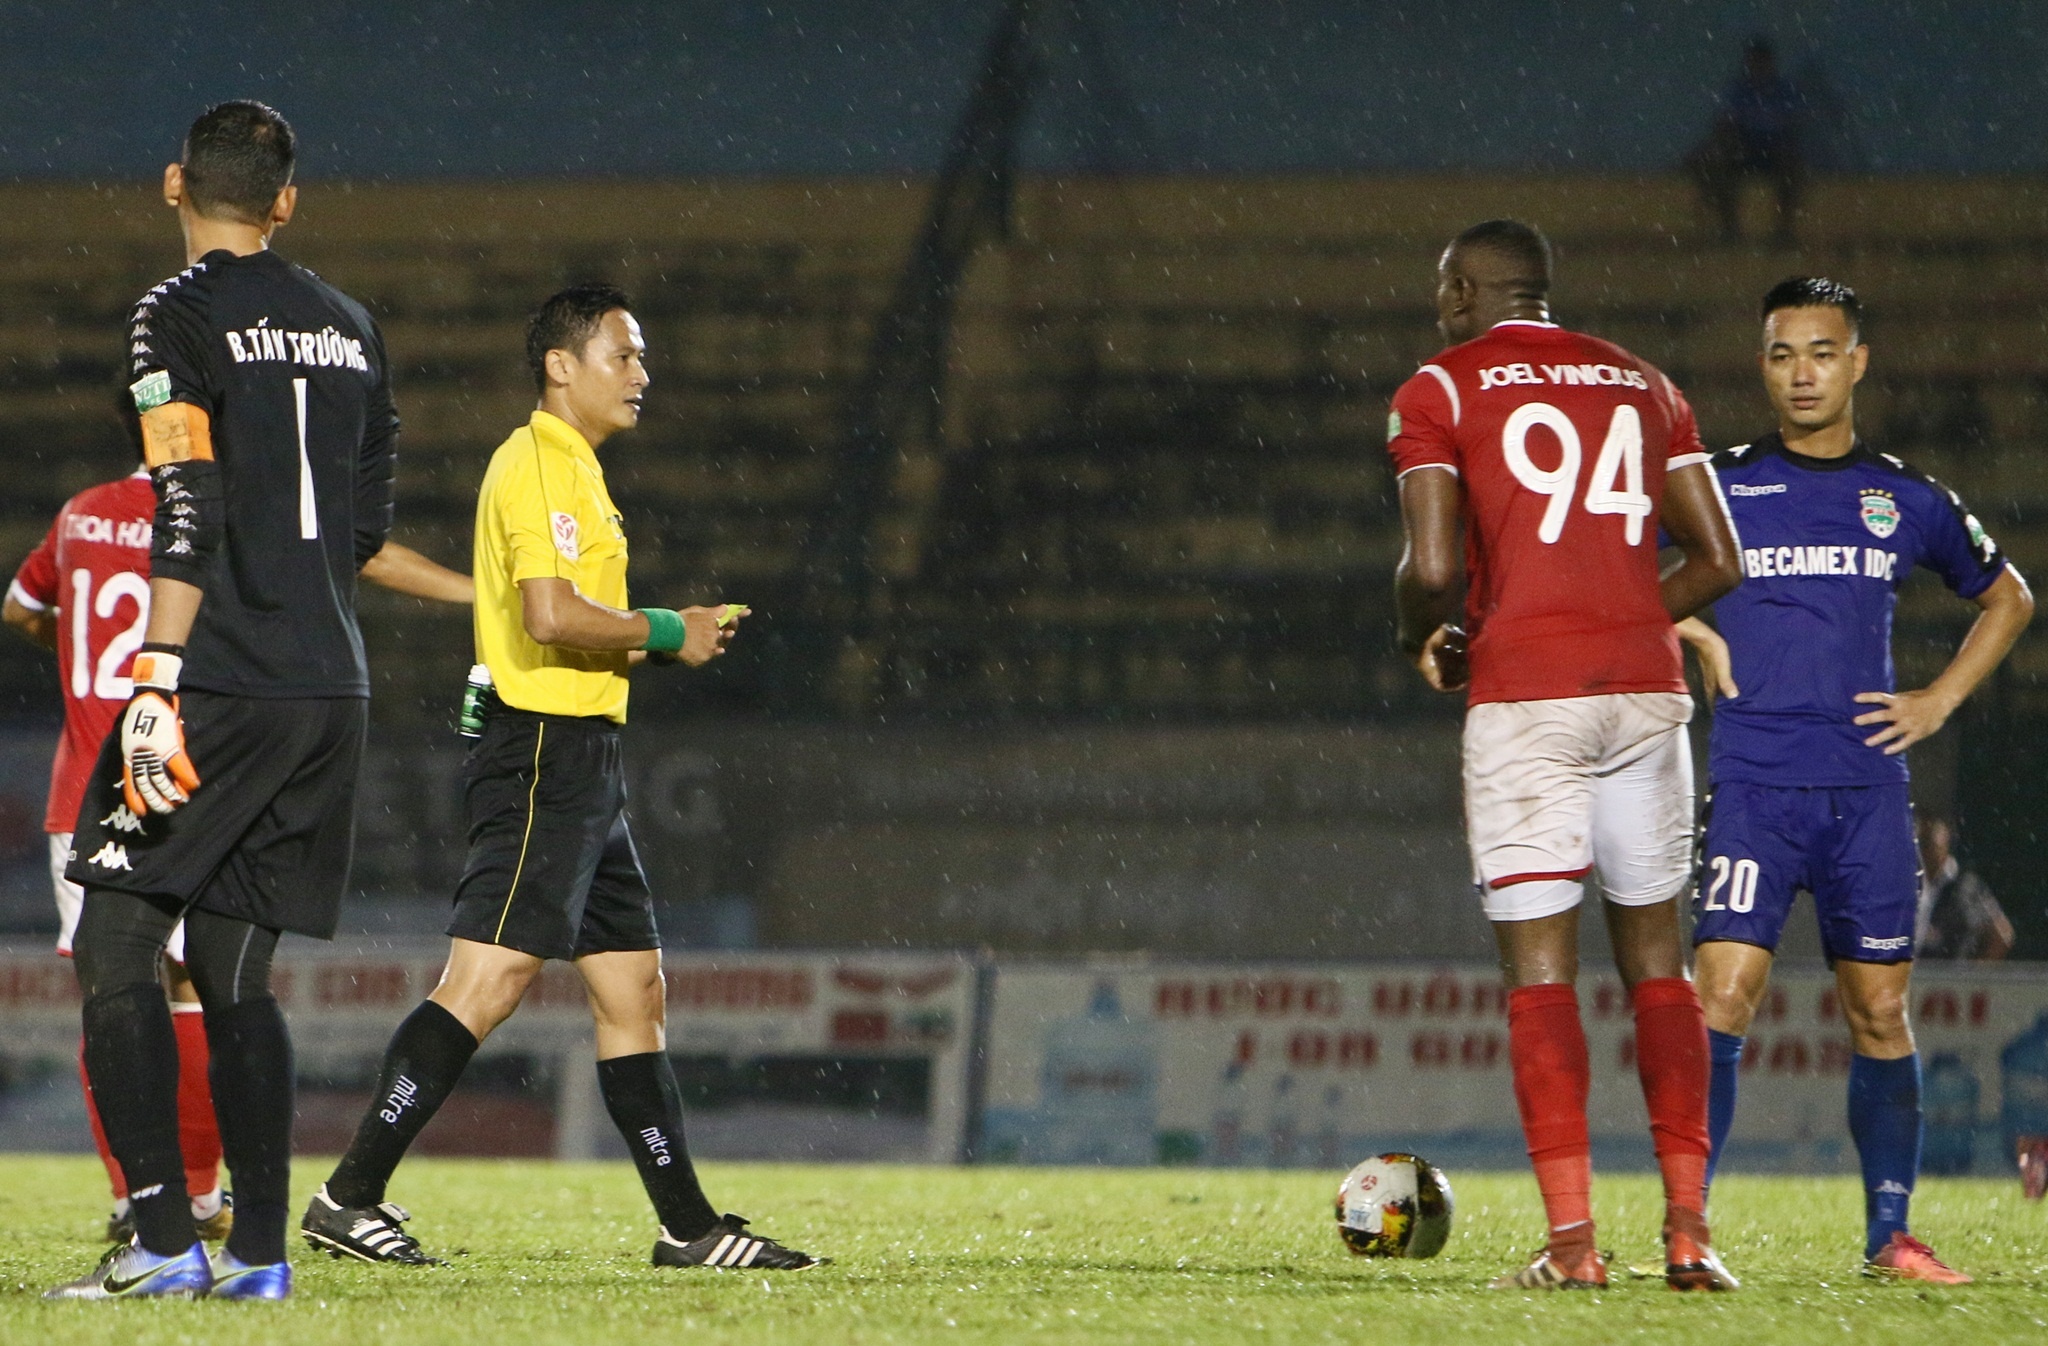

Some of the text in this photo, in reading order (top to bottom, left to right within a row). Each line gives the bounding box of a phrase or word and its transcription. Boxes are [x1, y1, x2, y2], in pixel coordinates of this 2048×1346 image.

[226, 317, 368, 372] B.TẤN TRƯỜNG
[1478, 363, 1648, 391] JOEL VINICIUS
[293, 378, 317, 540] 1
[1502, 402, 1653, 547] 94
[1743, 546, 1898, 582] BECAMEX IDC
[71, 567, 151, 700] 12
[1704, 855, 1760, 914] 20
[379, 1074, 417, 1124] mitre
[639, 1126, 671, 1166] mitre
